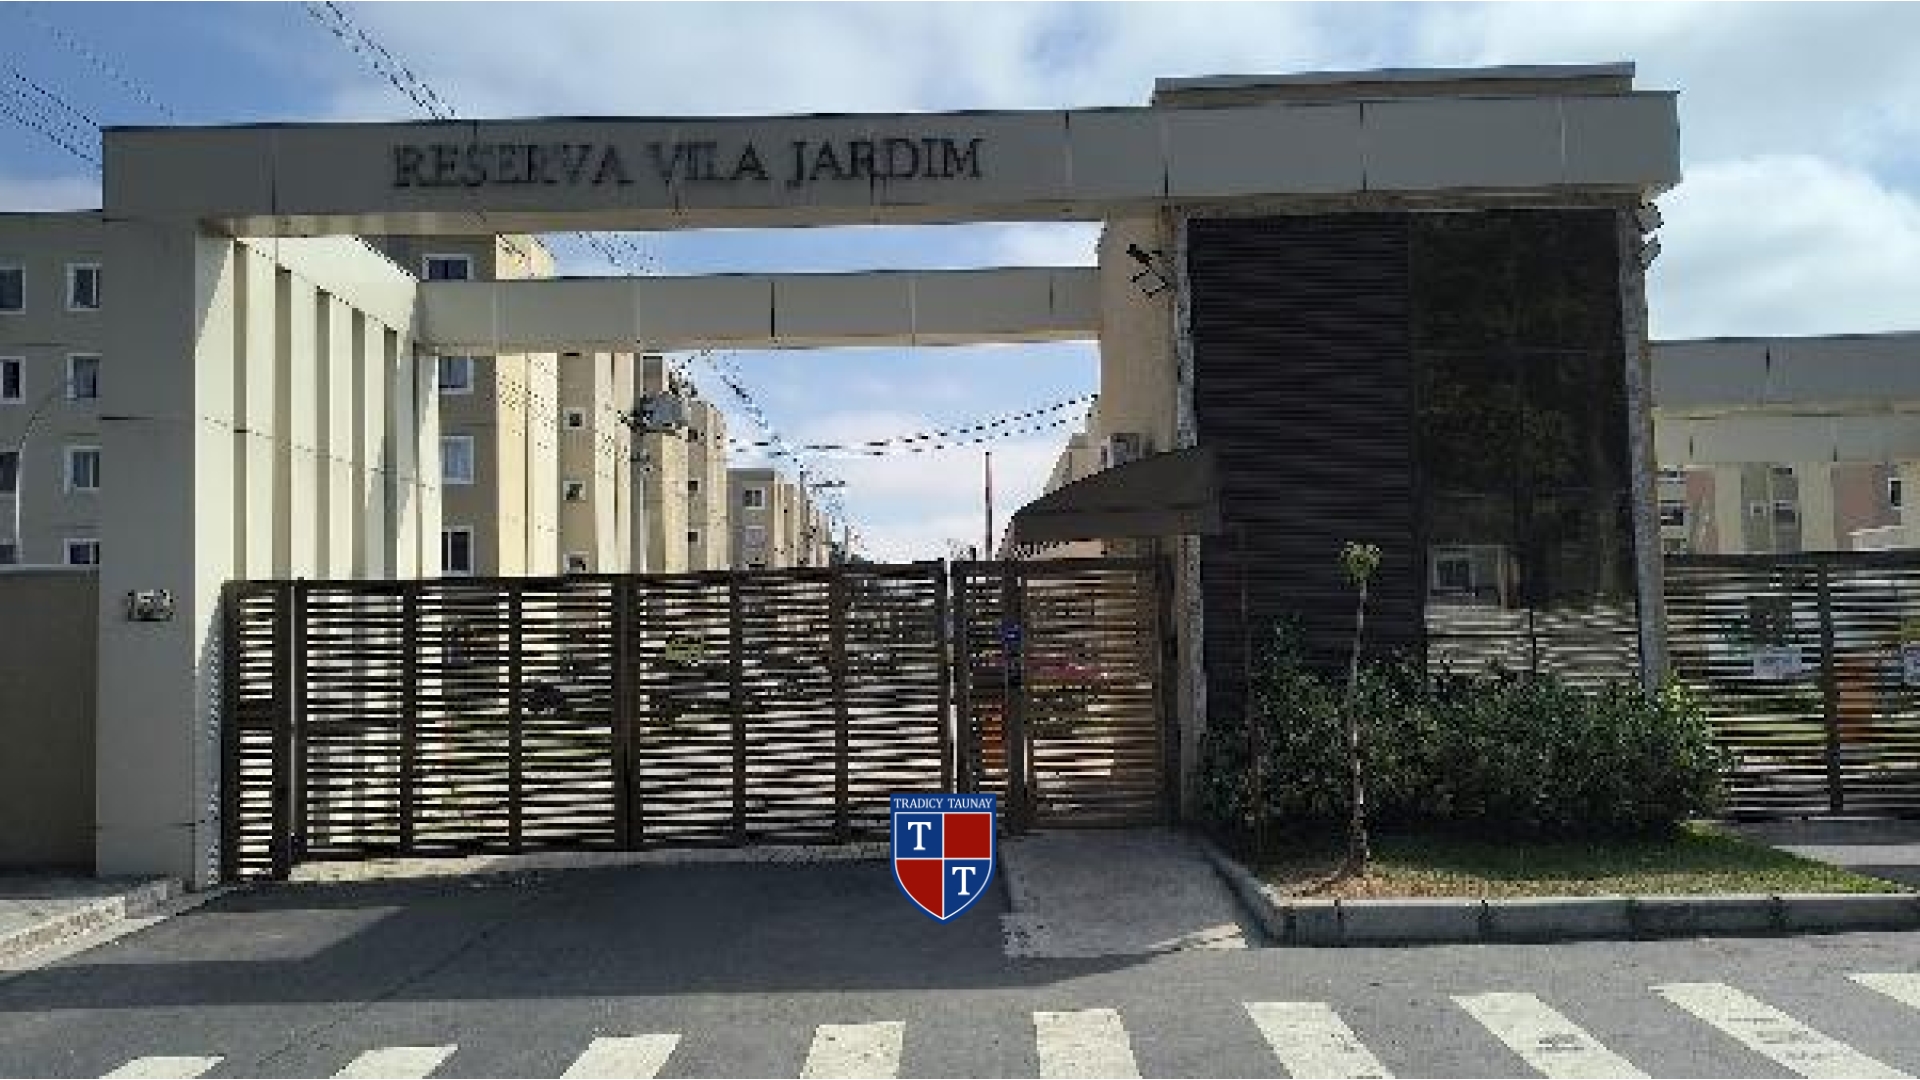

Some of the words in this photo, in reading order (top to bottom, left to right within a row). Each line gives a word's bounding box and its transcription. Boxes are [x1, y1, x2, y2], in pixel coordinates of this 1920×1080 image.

[393, 143, 635, 188] RESERVA
[643, 141, 769, 184] VILA
[785, 137, 984, 189] JARDIM
